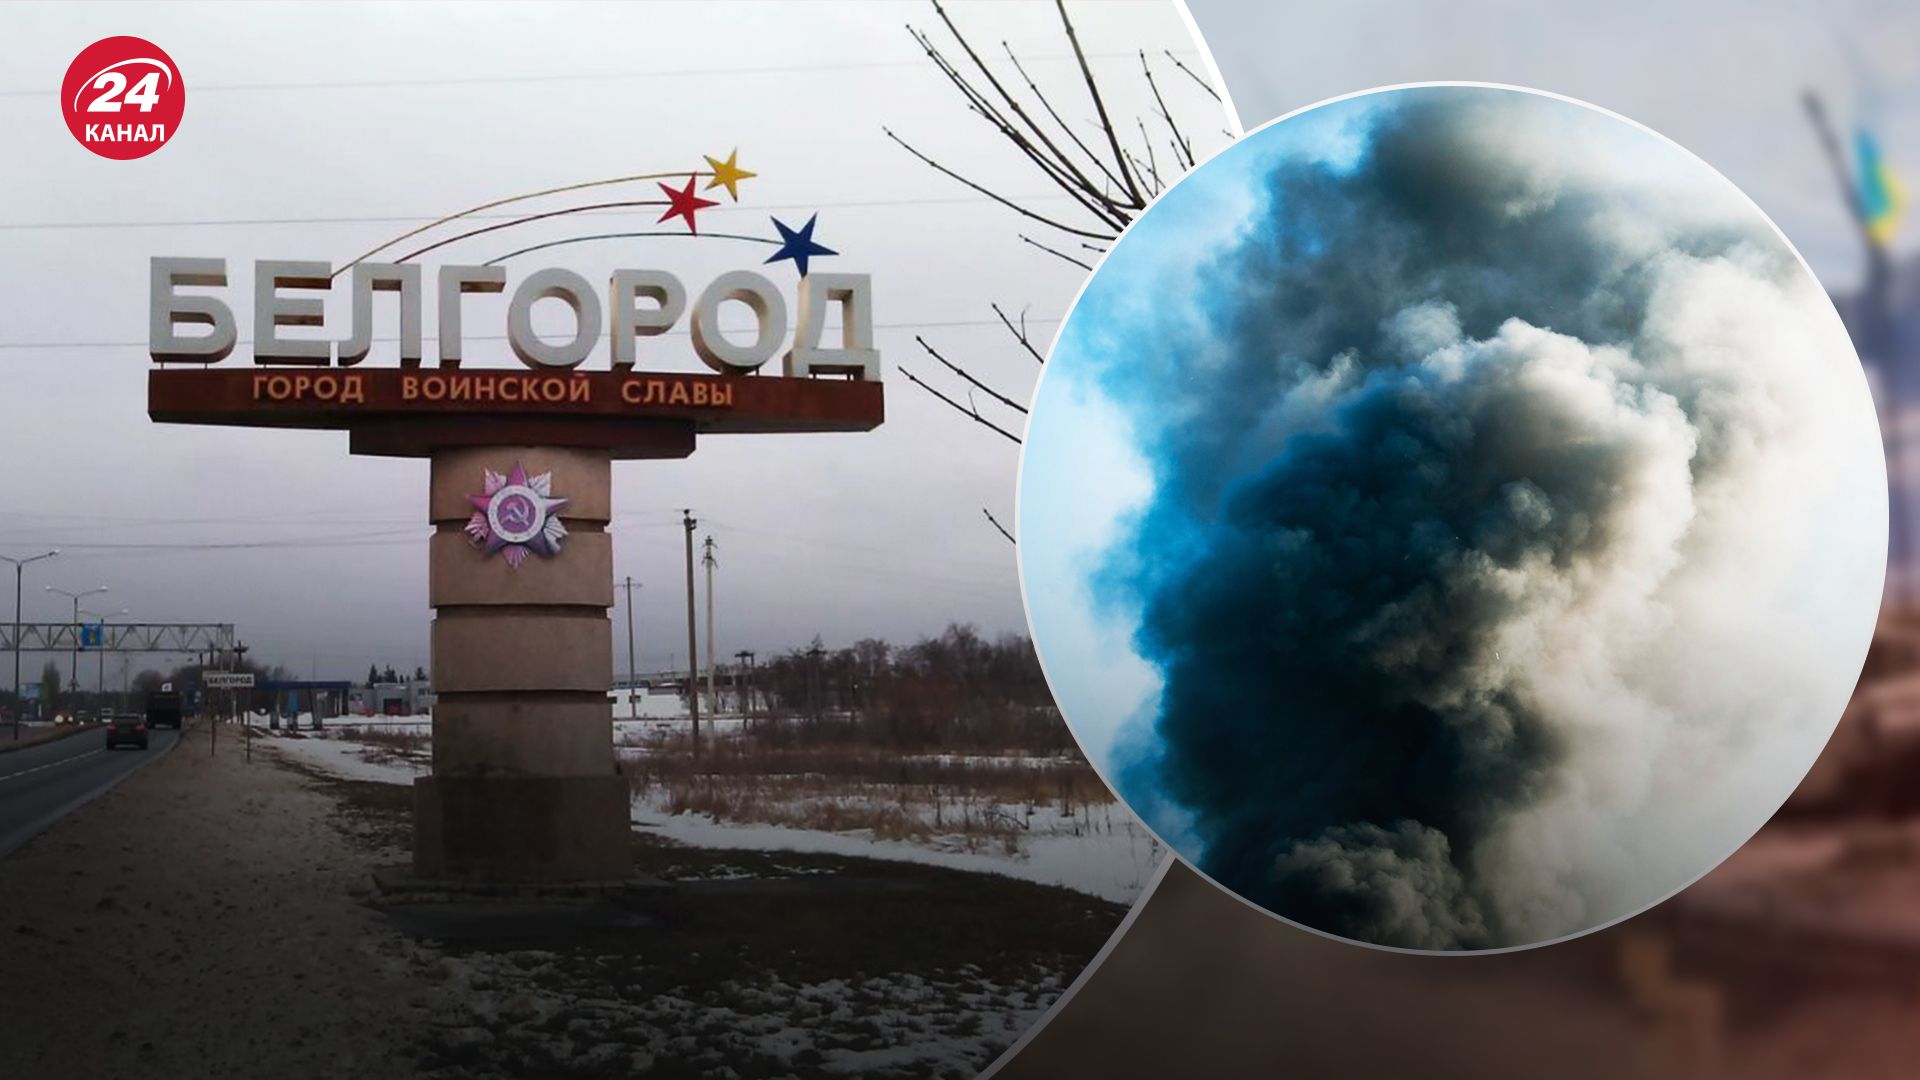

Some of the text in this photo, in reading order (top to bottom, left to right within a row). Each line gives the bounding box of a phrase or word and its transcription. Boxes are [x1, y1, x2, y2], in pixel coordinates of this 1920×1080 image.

[150, 256, 880, 380] БЕЛГОРОД
[252, 373, 733, 406] ГОРОД ВОИНСКОЙ СЛАВЫ
